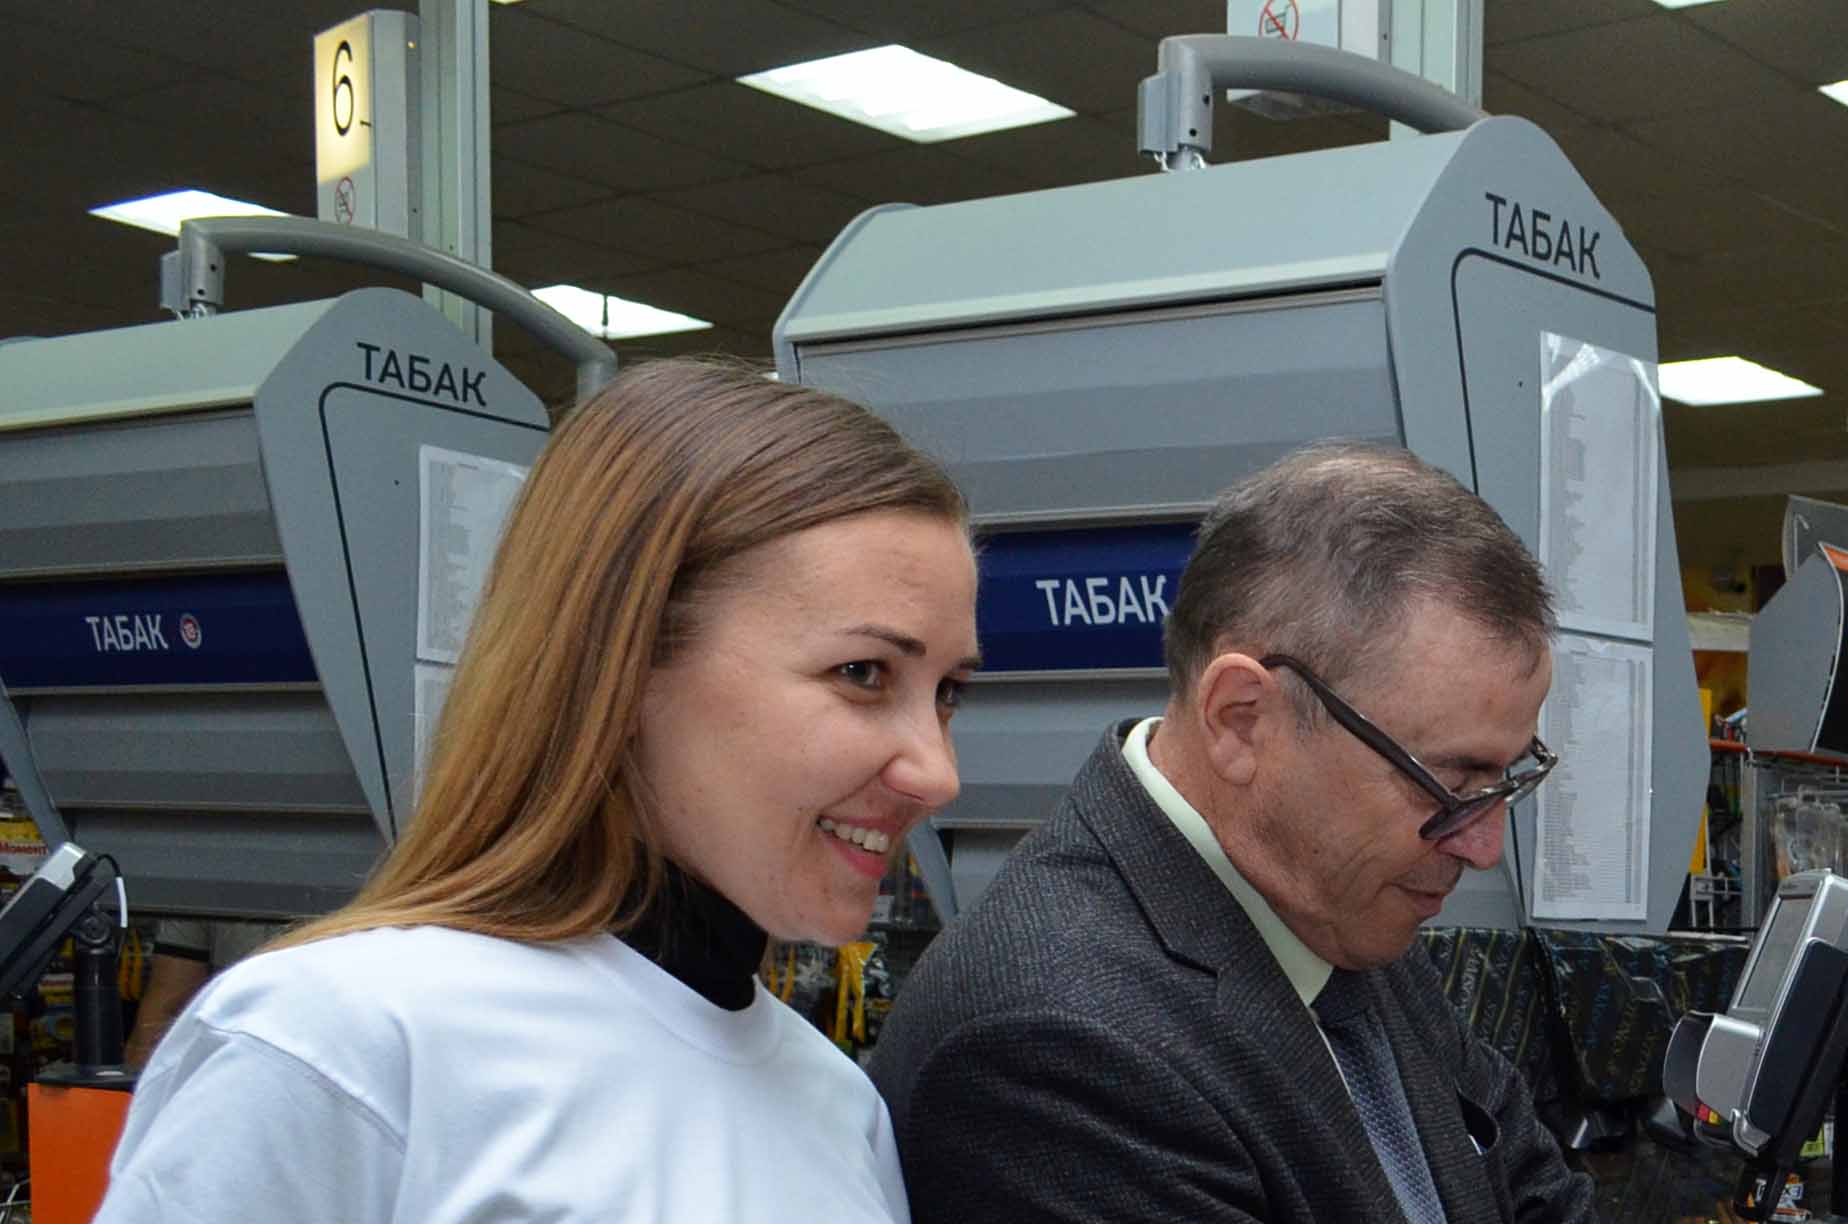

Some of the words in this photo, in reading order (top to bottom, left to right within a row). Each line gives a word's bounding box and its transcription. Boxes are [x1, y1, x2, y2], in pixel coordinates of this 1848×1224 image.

[333, 40, 354, 136] 6
[1485, 191, 1600, 280] ТАБАК
[356, 341, 487, 407] ТАБАК
[85, 614, 169, 651] ТАБАК
[1036, 575, 1170, 626] ТАБАК
